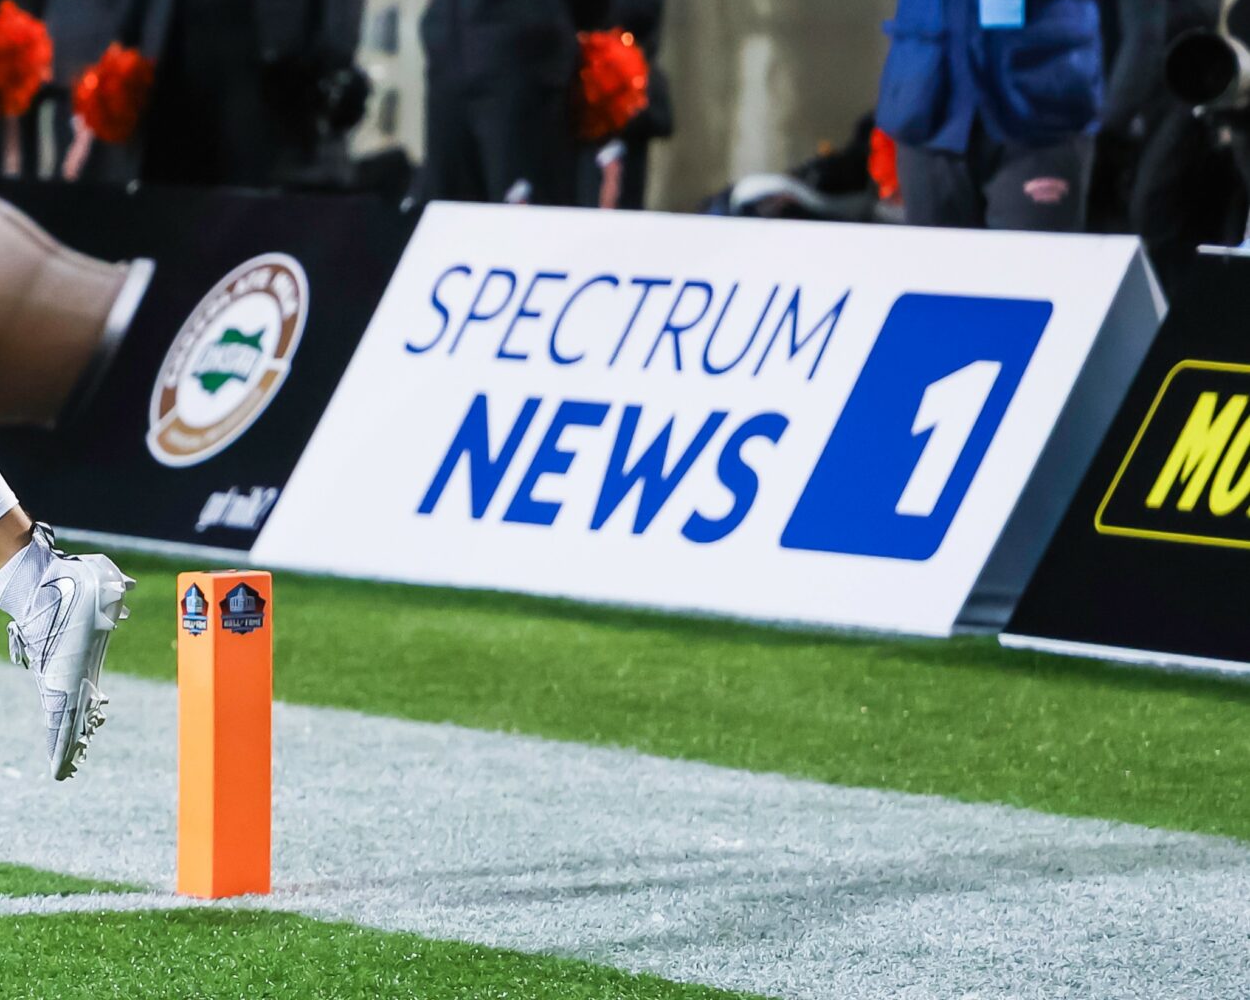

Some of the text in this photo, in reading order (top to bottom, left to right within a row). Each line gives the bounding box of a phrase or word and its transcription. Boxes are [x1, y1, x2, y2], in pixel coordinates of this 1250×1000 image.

[405, 265, 851, 381] SPECTRUM
[416, 360, 1002, 543] NEWS 1
[1146, 391, 1250, 516] MO
